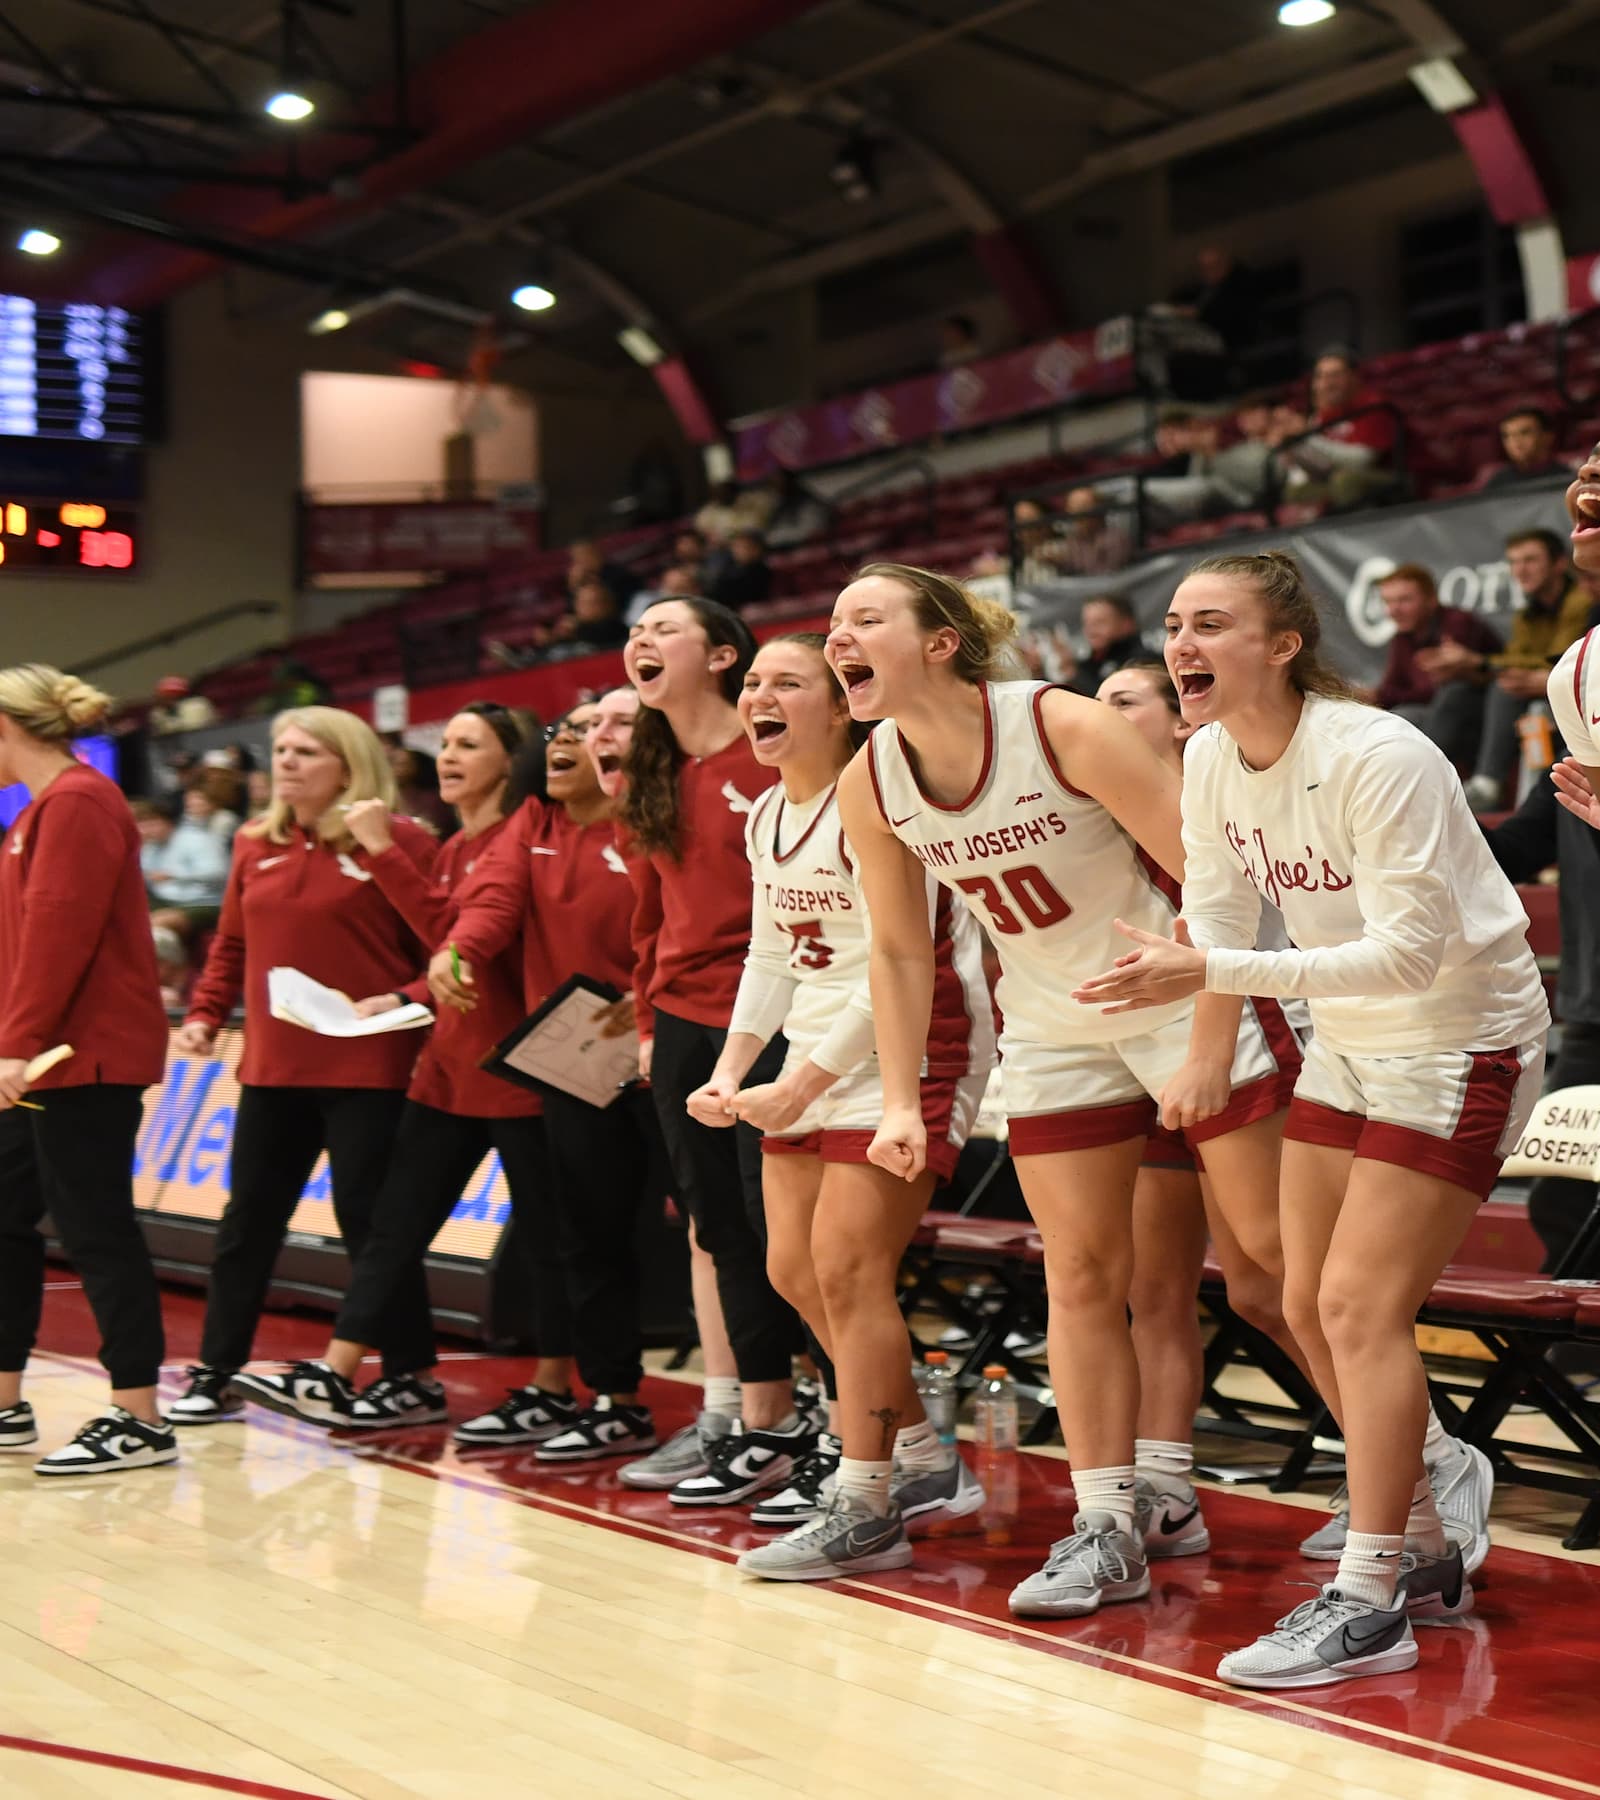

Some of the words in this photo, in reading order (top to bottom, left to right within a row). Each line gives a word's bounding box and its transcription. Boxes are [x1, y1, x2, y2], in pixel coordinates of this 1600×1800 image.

[909, 840, 959, 867] AINT
[964, 811, 1067, 862] JOSEPH'S
[1252, 827, 1353, 908] Joe's
[775, 886, 853, 913] JOSEPH'S
[953, 864, 1074, 936] 30
